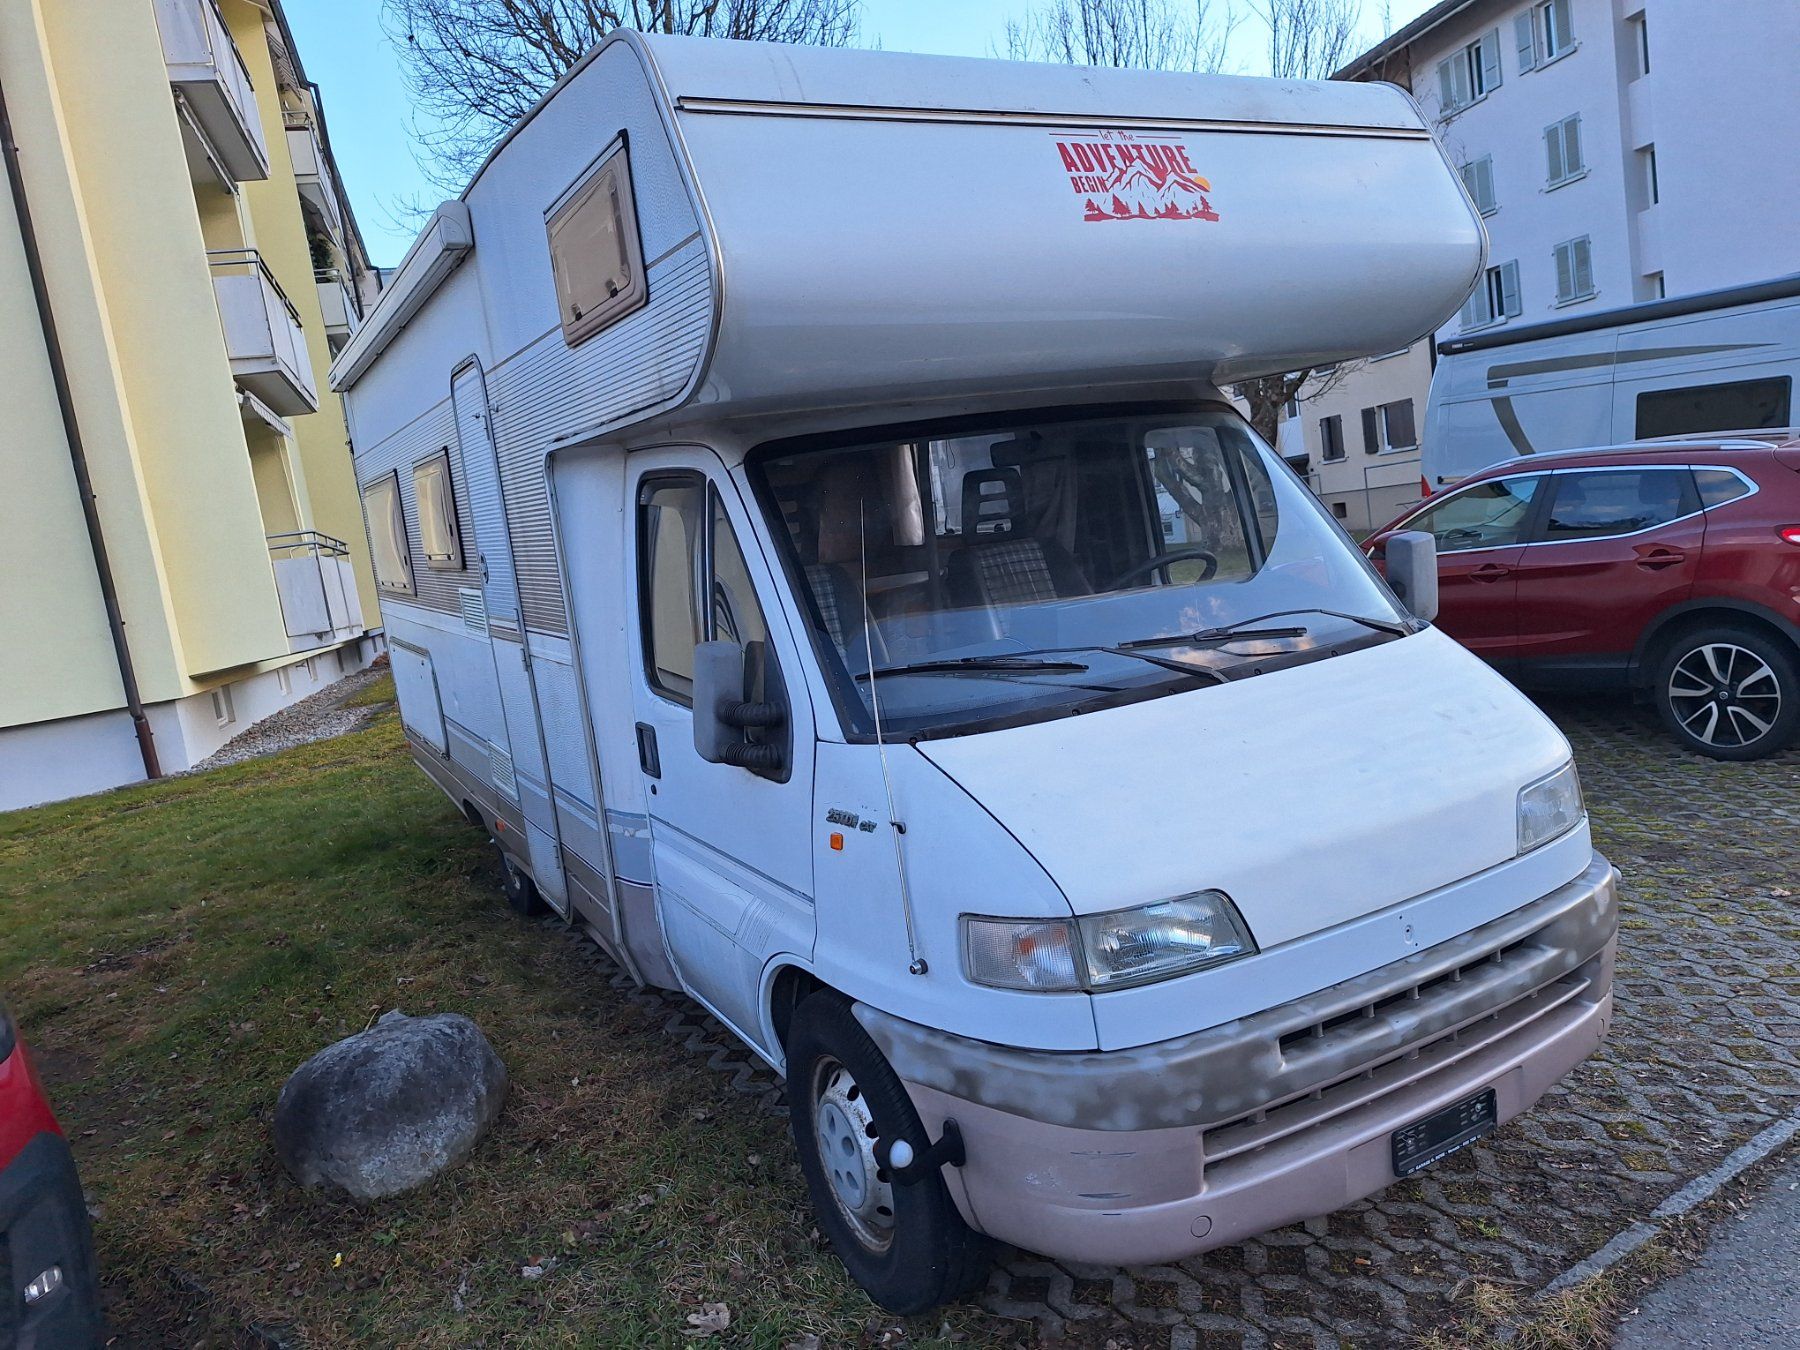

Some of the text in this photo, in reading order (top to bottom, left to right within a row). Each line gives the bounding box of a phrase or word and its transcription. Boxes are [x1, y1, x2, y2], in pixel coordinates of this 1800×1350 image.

[1099, 130, 1135, 141] let the
[1056, 142, 1199, 174] ADVENTURE
[1070, 175, 1109, 194] BEGIN
